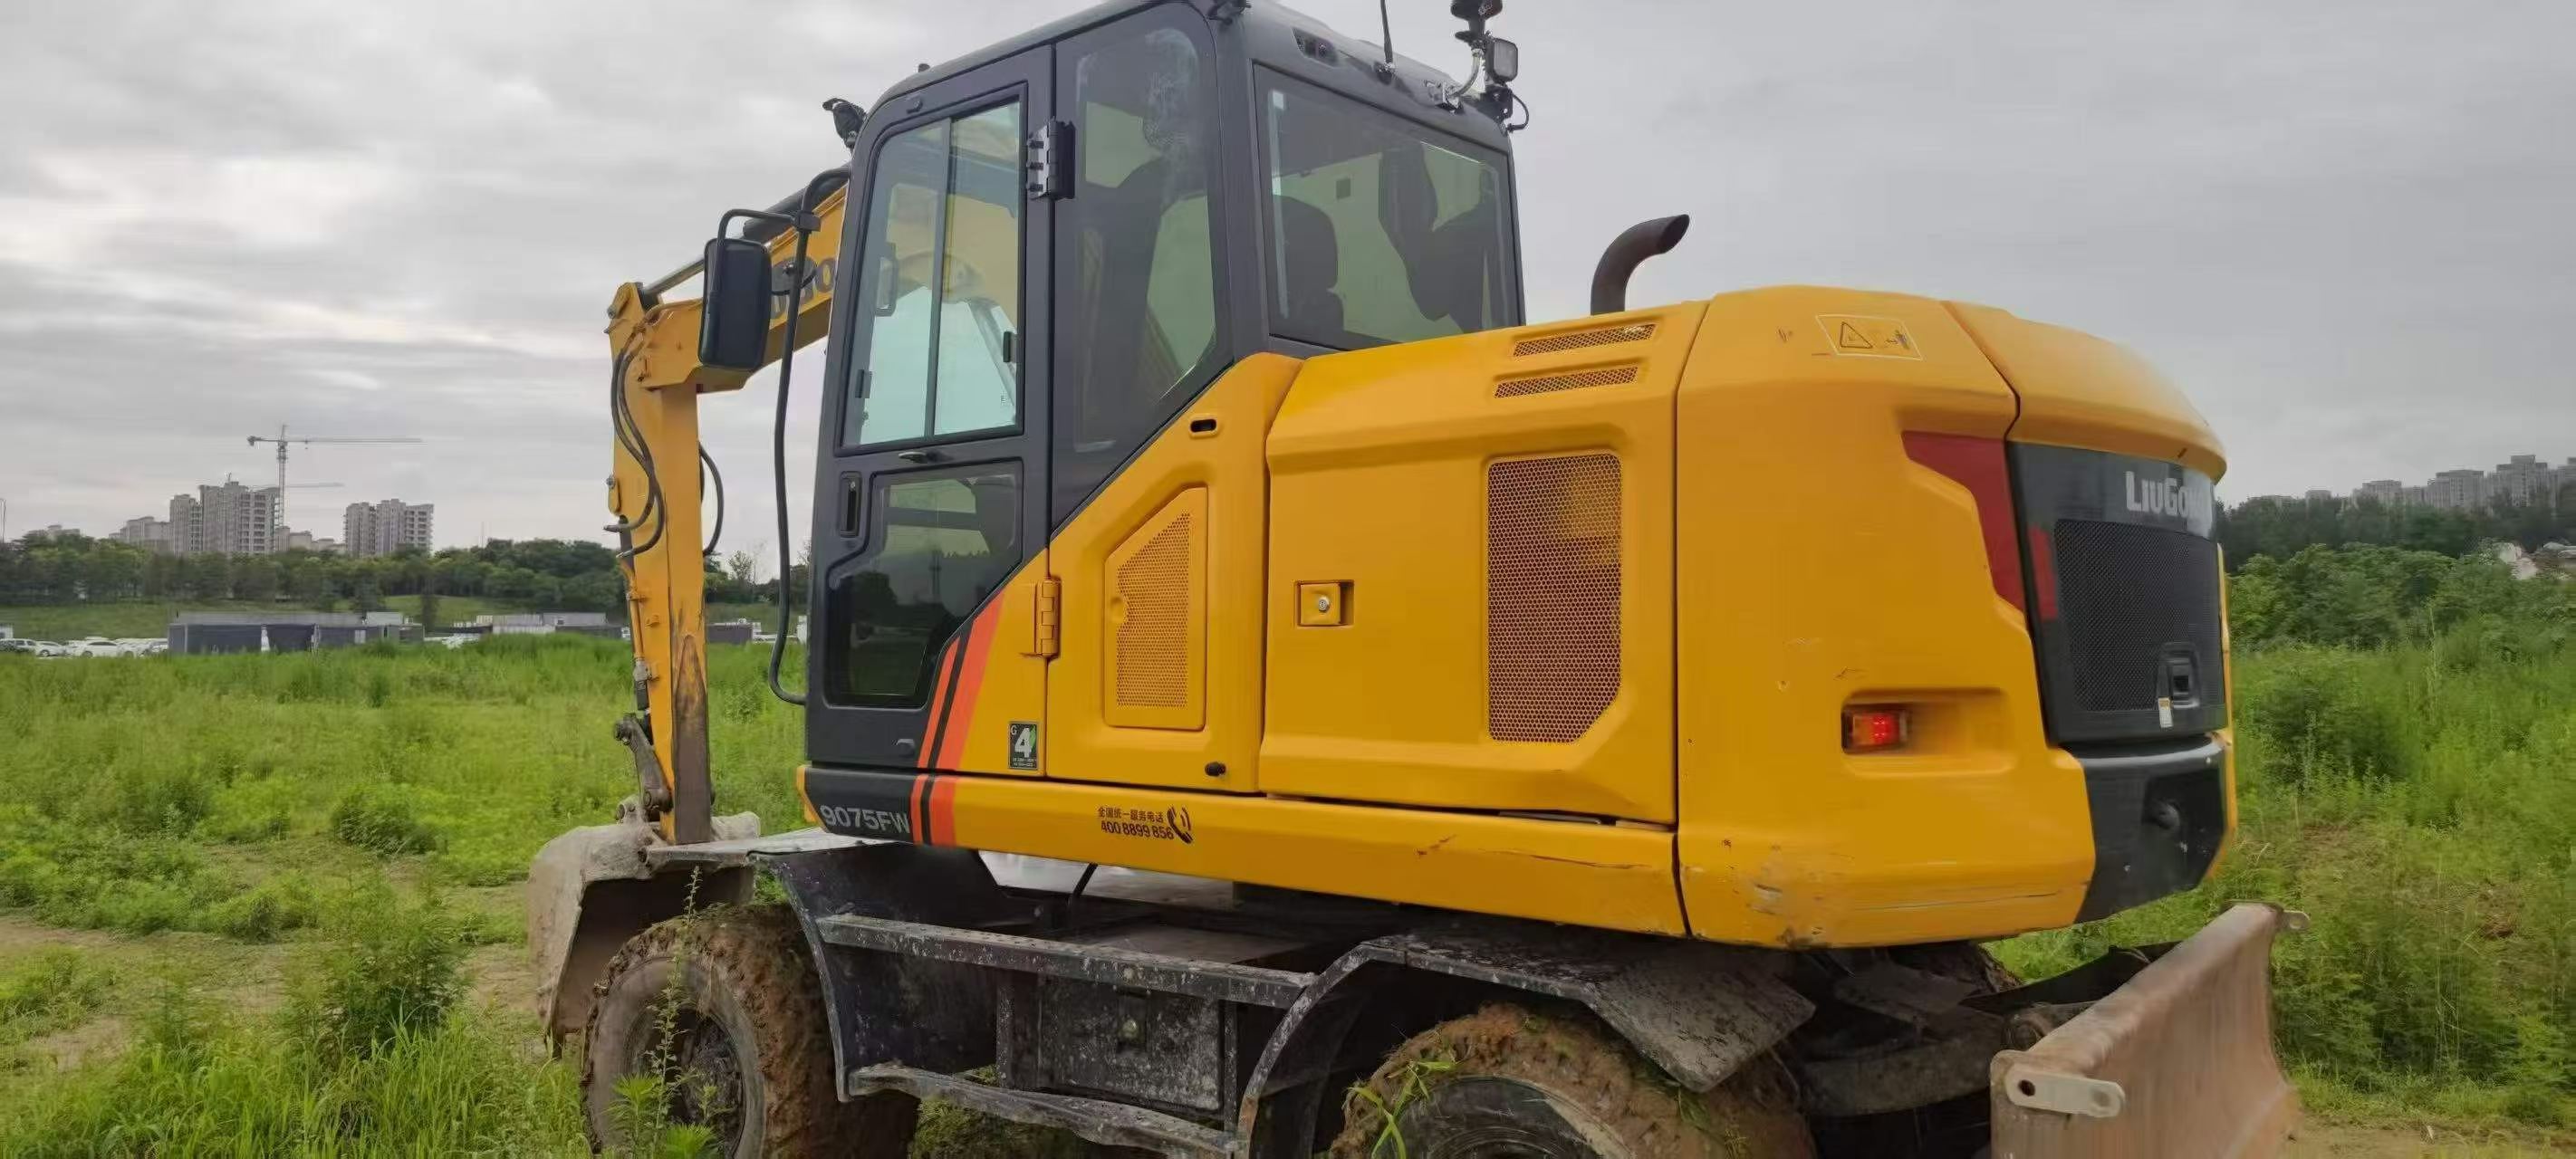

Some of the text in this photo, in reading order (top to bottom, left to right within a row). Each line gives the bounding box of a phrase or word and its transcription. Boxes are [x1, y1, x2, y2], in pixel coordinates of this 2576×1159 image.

[820, 805, 910, 834] 9075FW
[1101, 820, 1175, 840] 400 8899 856
